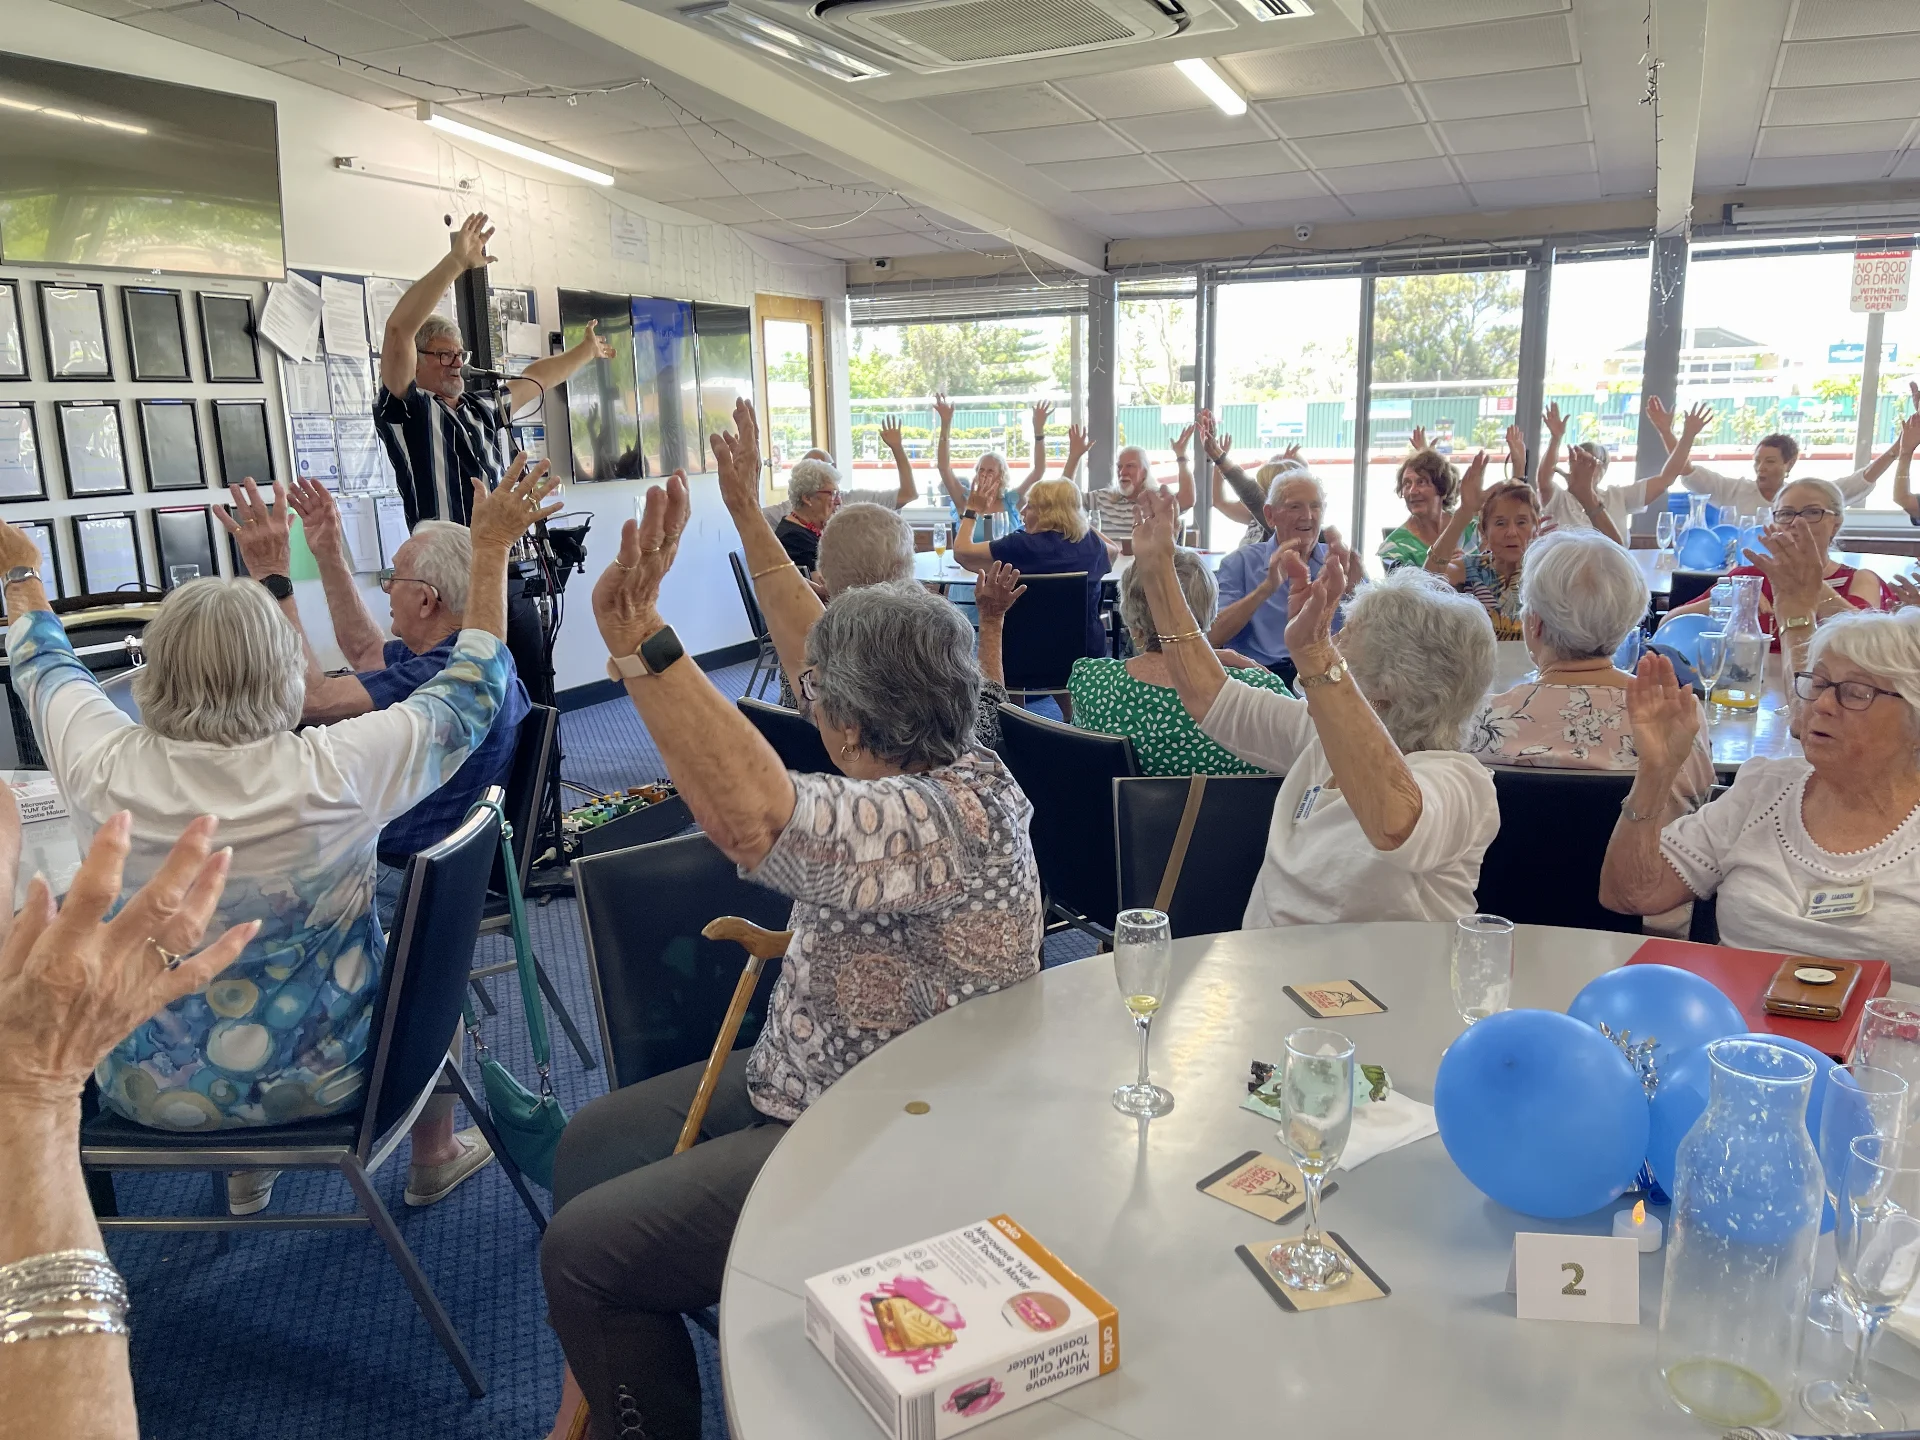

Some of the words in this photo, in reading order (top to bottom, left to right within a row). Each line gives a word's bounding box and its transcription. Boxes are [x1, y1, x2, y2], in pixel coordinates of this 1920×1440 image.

[1857, 262, 1873, 273] NO
[1876, 261, 1907, 273] FOOD
[1855, 274, 1870, 285] OR
[1873, 273, 1906, 285] DRINK
[1860, 287, 1887, 295] WITHIN
[1863, 294, 1907, 302] SYNTHETIC
[1865, 302, 1892, 310] GREEN
[21, 800, 55, 808] Microwave
[23, 812, 45, 820] Toastie
[1241, 1170, 1277, 1194] GREAT
[997, 1219, 1021, 1240] anko
[974, 1226, 1015, 1262] Microwave
[1003, 1266, 1031, 1290] Maker
[1561, 1262, 1587, 1296] 2
[1048, 1334, 1090, 1357] Toastie
[1103, 1326, 1115, 1365] anko
[1006, 1350, 1045, 1373] Maker
[1030, 1361, 1053, 1381] Grill
[1025, 1361, 1090, 1392] Microwave
